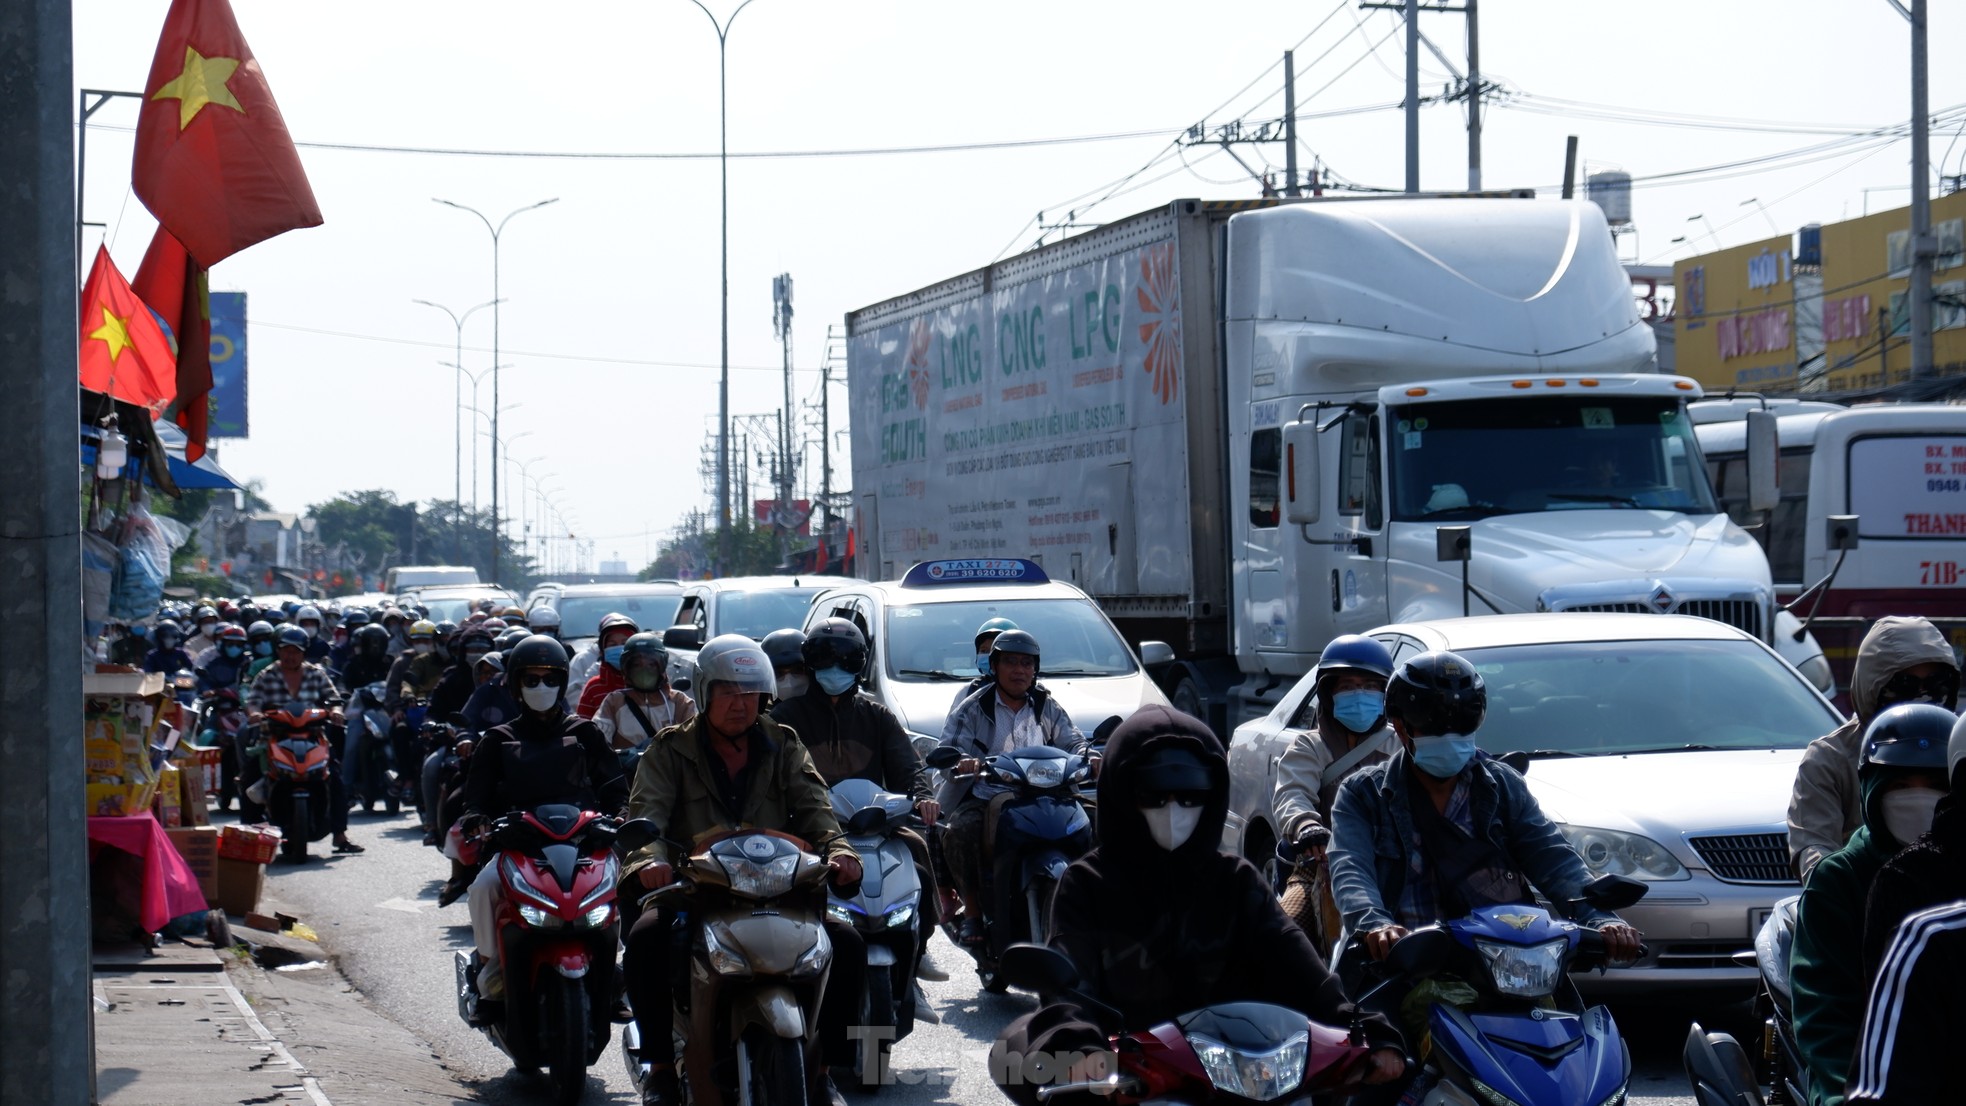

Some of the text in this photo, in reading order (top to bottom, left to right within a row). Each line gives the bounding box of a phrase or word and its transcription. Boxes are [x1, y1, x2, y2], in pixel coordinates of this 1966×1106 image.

[940, 284, 1120, 390] LNG CNG LPG
[881, 418, 926, 464] SOUTH
[1925, 446, 1948, 458] BX.
[1924, 463, 1947, 475] BX.
[1927, 479, 1961, 492] 0948
[946, 561, 981, 569] TAXI
[961, 569, 974, 577] 39
[977, 569, 996, 577] 620
[998, 569, 1018, 577] 620
[1919, 561, 1966, 585] 71B-
[1593, 1012, 1602, 1031] 150
